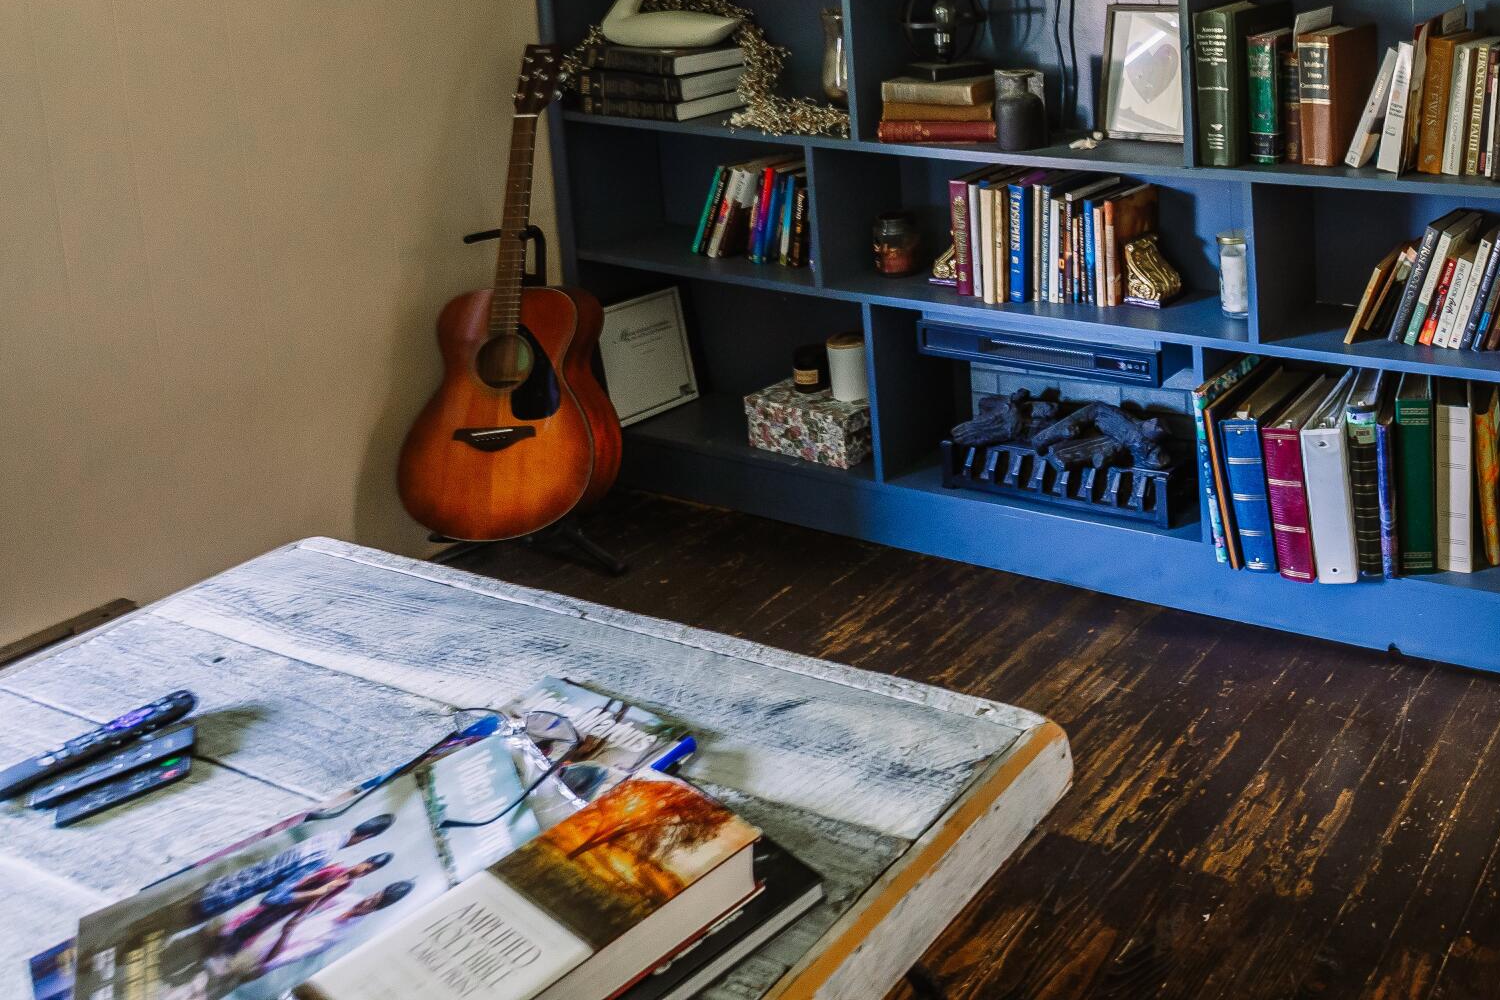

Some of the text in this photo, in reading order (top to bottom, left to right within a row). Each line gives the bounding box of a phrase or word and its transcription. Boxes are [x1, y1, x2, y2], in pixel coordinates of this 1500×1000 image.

[1425, 85, 1439, 126] LEWIS
[1470, 46, 1488, 151] HEROES OF THE FAITH
[1010, 199, 1021, 252] JOSEPHUS
[1084, 212, 1093, 254] UPRISING
[1410, 246, 1430, 290] RISE ABOVE
[1455, 271, 1464, 287] CASE
[1458, 262, 1466, 272] THE
[1446, 296, 1457, 314] faith
[573, 707, 658, 752] Martyrs
[455, 749, 497, 797] Voice
[409, 940, 447, 972] LARGE
[422, 915, 512, 988] HOLY BIBLE
[455, 901, 543, 969] AMPLIFIED
